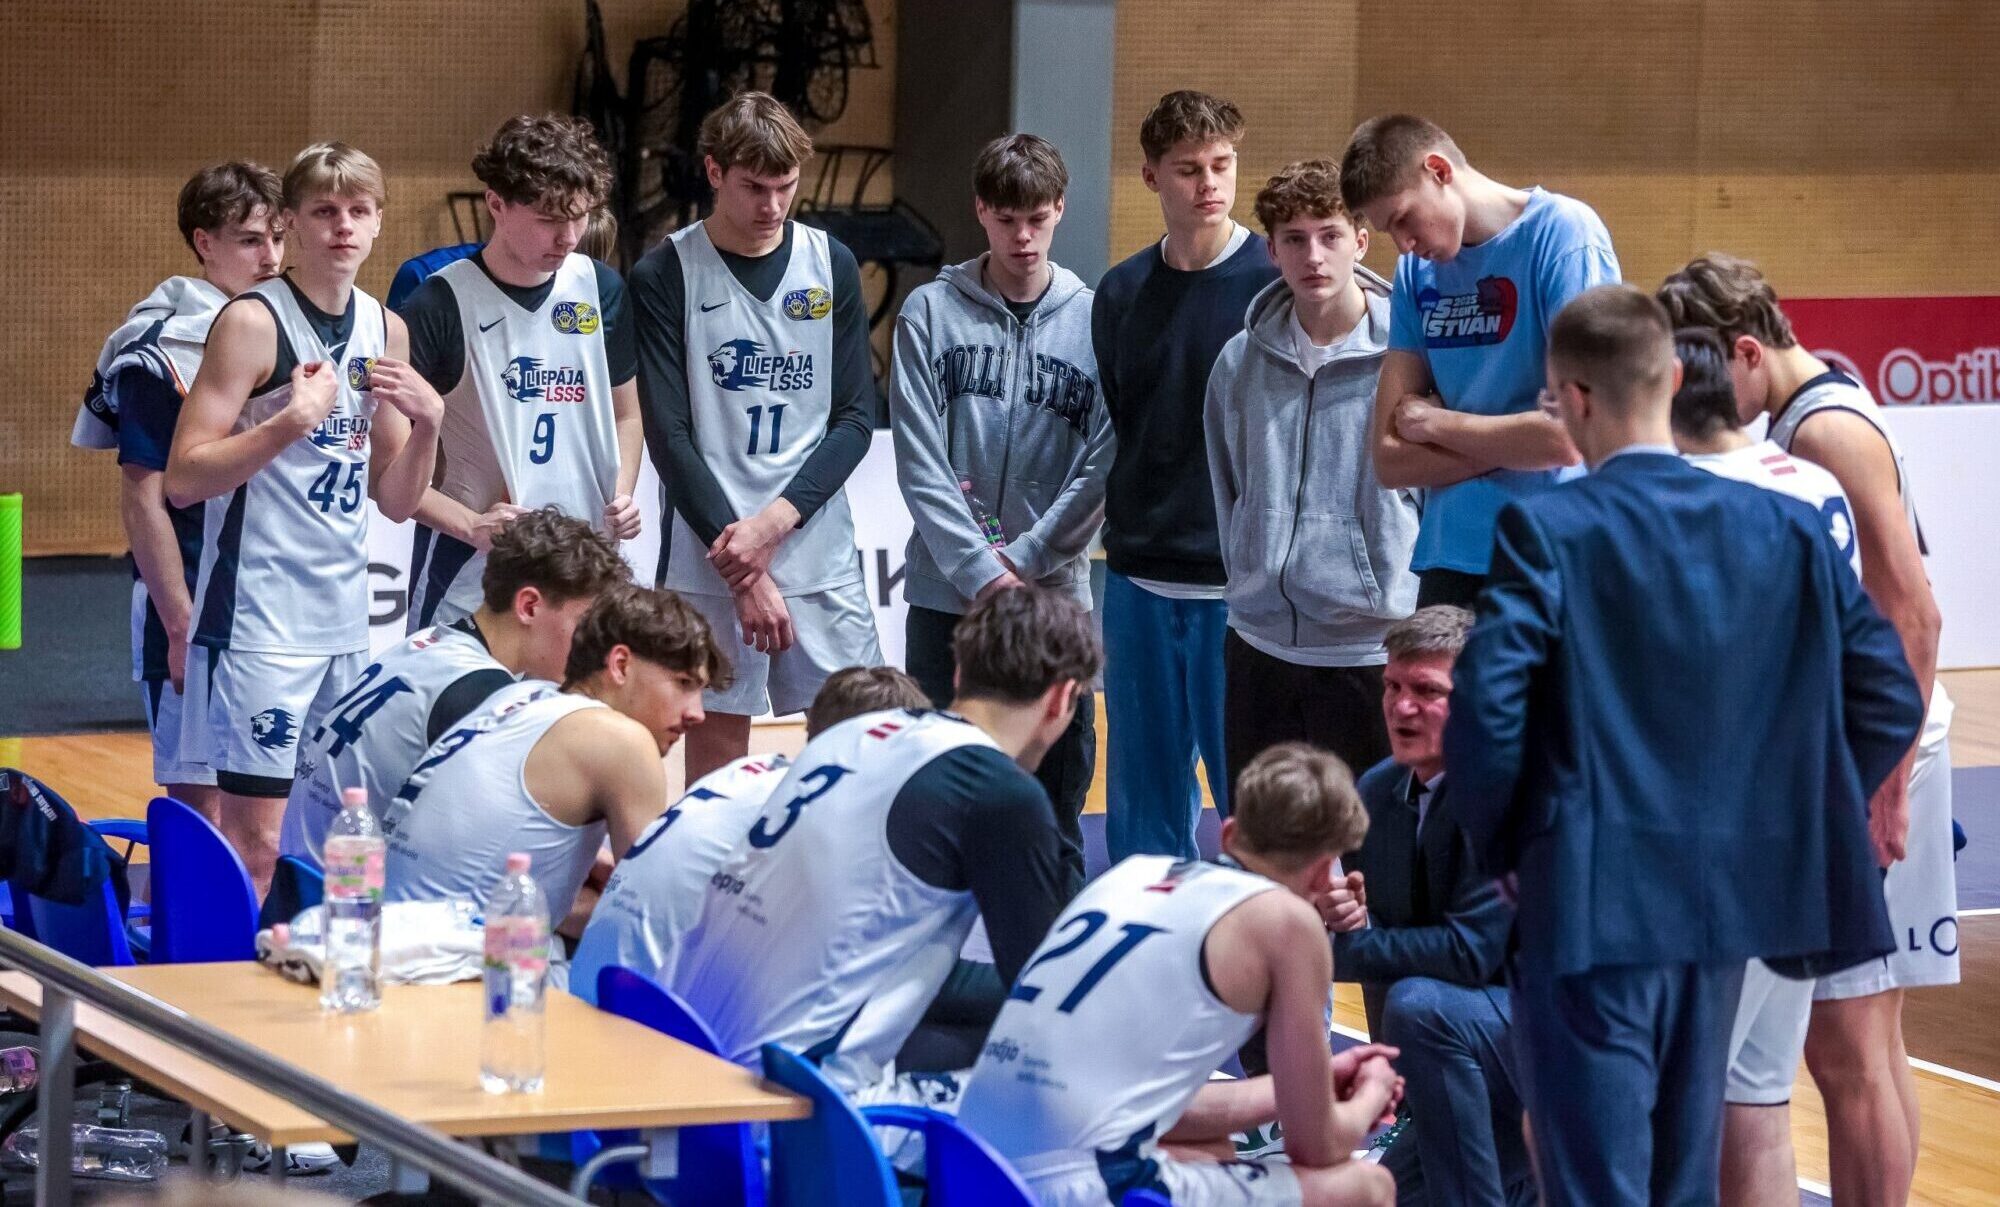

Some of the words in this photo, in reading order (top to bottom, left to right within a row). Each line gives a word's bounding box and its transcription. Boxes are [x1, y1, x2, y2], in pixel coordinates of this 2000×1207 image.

[1422, 310, 1501, 337] ISTVÁN
[526, 366, 585, 386] LIEPĀJA
[744, 350, 814, 375] LIEPĀJA
[769, 372, 814, 391] LSSS
[545, 386, 585, 403] LSSS
[529, 412, 559, 465] 9
[746, 403, 790, 455] 11
[308, 461, 367, 514] 45
[748, 765, 856, 849] 3
[1009, 910, 1175, 1016] 21
